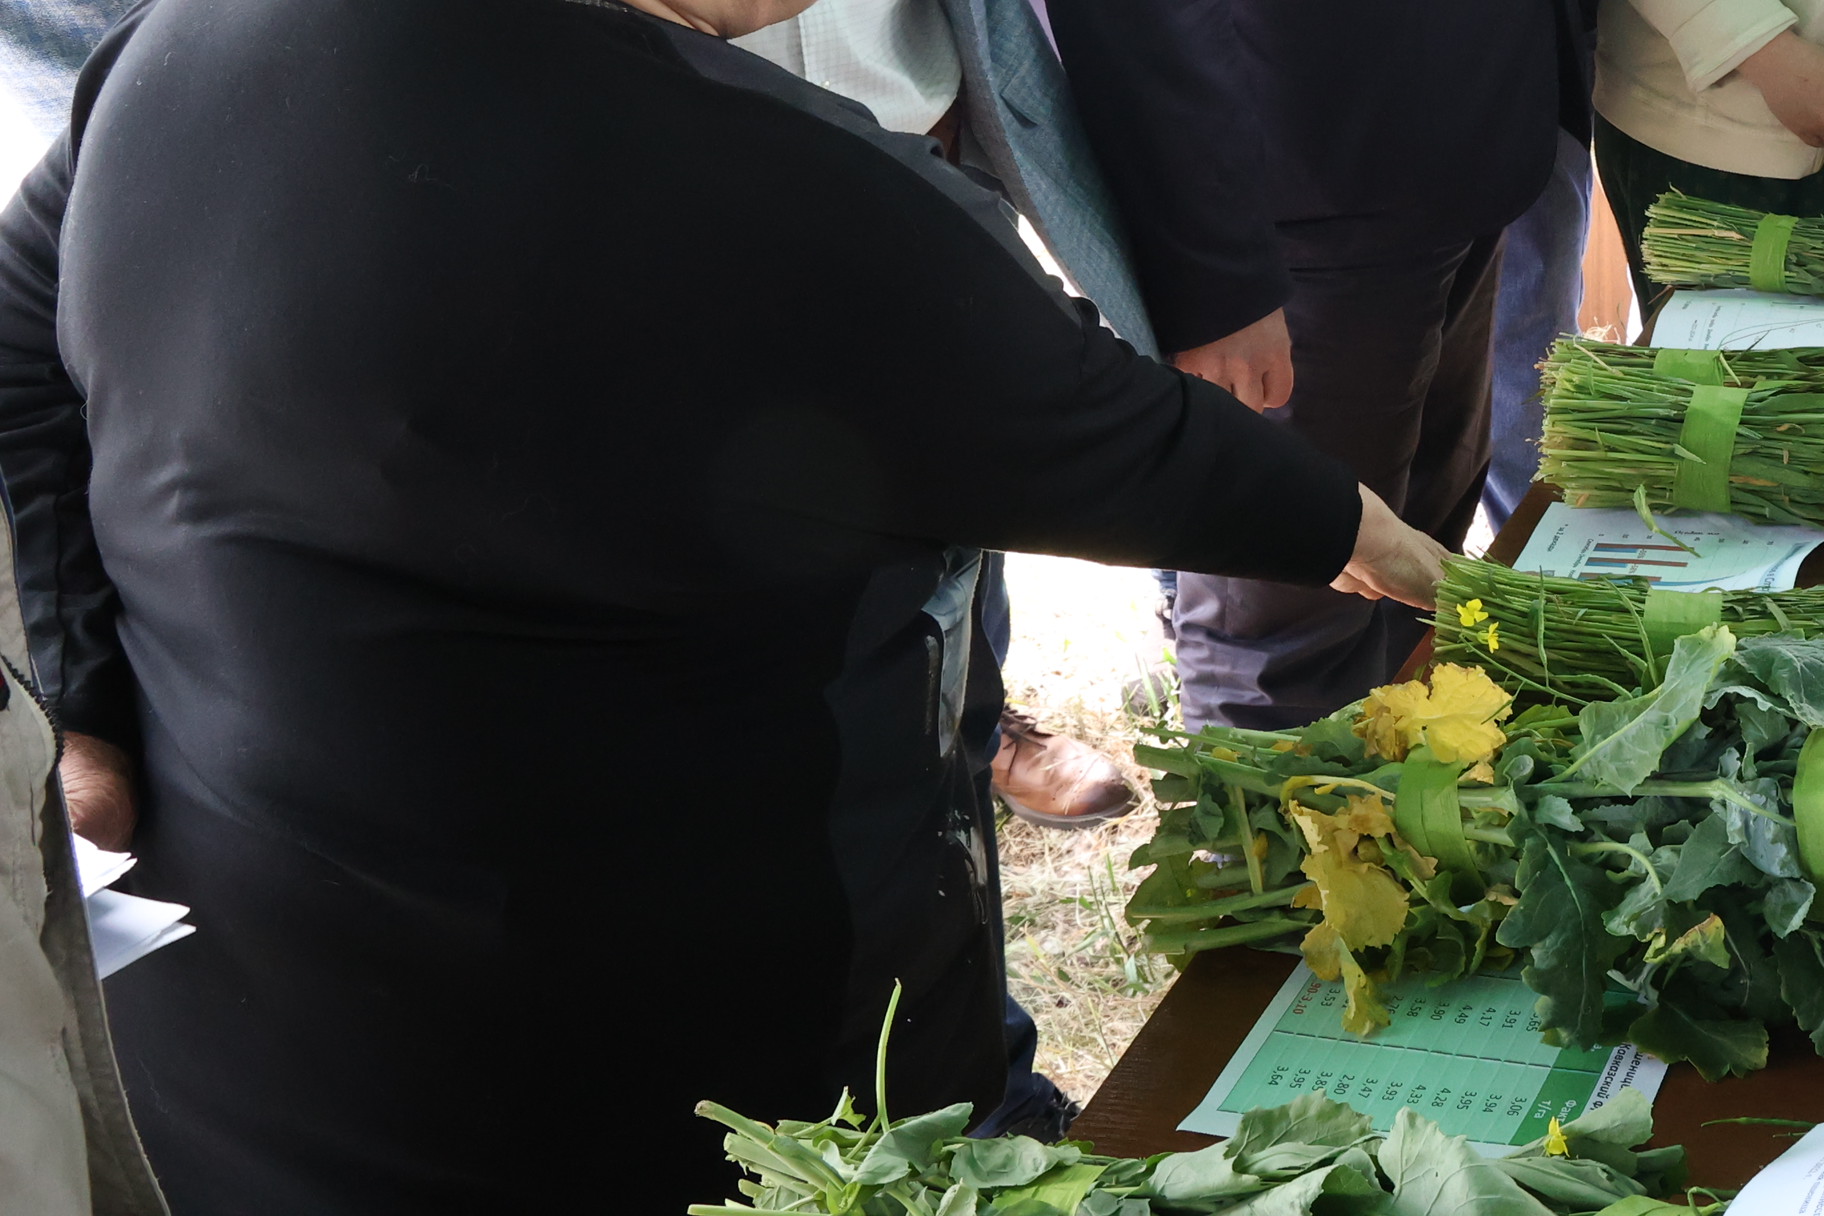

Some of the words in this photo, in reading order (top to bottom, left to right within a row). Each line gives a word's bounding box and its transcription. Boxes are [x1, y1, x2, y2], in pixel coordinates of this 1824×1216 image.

[1293, 982, 1322, 1015] 90-3,10
[1320, 988, 1341, 1007] 3,53
[1406, 997, 1427, 1018] 3,58
[1430, 999, 1450, 1021] 3,90
[1454, 1004, 1473, 1025] 4,49
[1479, 1006, 1497, 1028] 4,17
[1501, 1009, 1522, 1029] 3,91
[1525, 1012, 1541, 1032] ,65
[1268, 1065, 1289, 1087] 3,64
[1289, 1068, 1311, 1089] 3,95
[1311, 1071, 1333, 1091] 3,85
[1619, 1051, 1644, 1091] шениц
[1333, 1074, 1356, 1095] 2,80
[1358, 1077, 1378, 1099] 3,47
[1381, 1081, 1403, 1102] 3,93
[1406, 1084, 1427, 1105] 4,33
[1431, 1087, 1452, 1108] 4,28
[1456, 1090, 1478, 1111] 3,95
[1482, 1093, 1502, 1113] 3,94
[1506, 1096, 1528, 1117] 3,06
[1533, 1100, 1552, 1119] т/га
[1557, 1099, 1577, 1123] Факт
